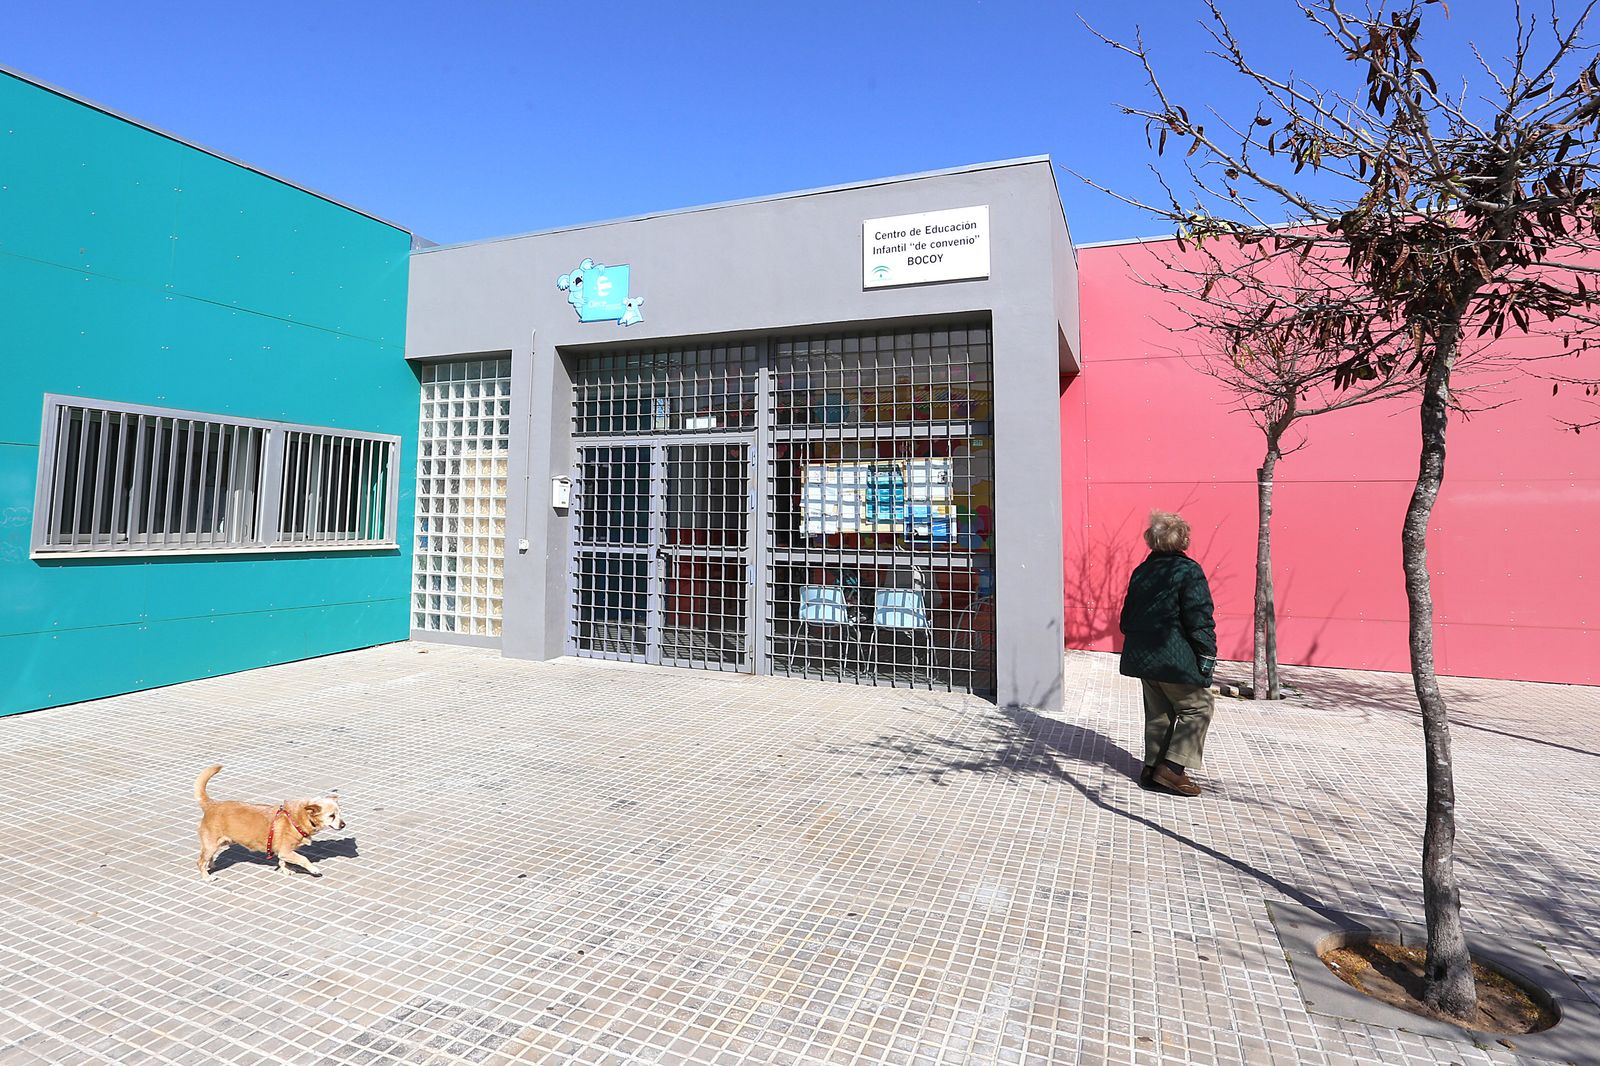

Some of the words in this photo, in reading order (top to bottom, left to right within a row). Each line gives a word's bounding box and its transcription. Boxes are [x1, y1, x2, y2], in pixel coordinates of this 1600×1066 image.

[874, 230, 907, 241] Centro
[909, 227, 922, 237] de
[925, 221, 977, 235] Educación
[872, 243, 907, 255] Infantil
[907, 254, 944, 266] BOCOY
